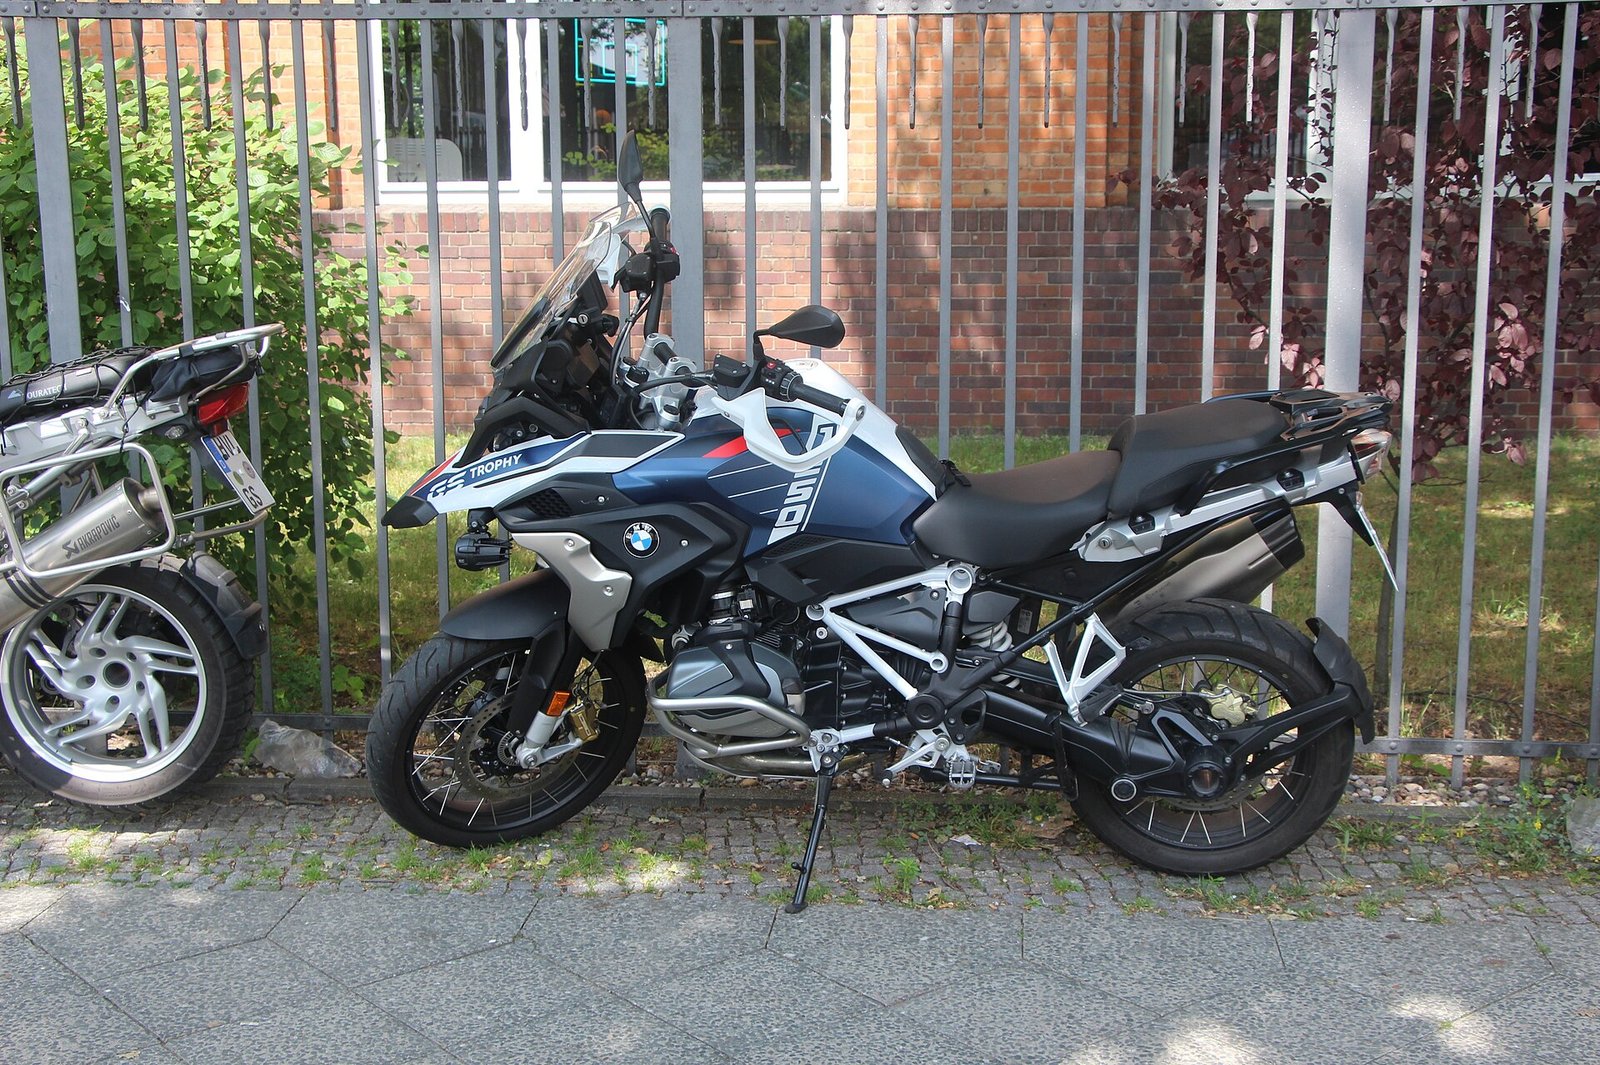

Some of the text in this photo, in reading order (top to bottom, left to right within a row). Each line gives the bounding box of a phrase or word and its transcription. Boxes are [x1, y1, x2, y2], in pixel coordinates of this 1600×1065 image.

[429, 453, 522, 497] GS TROPHY
[242, 485, 263, 509] GS
[625, 523, 652, 539] BMW
